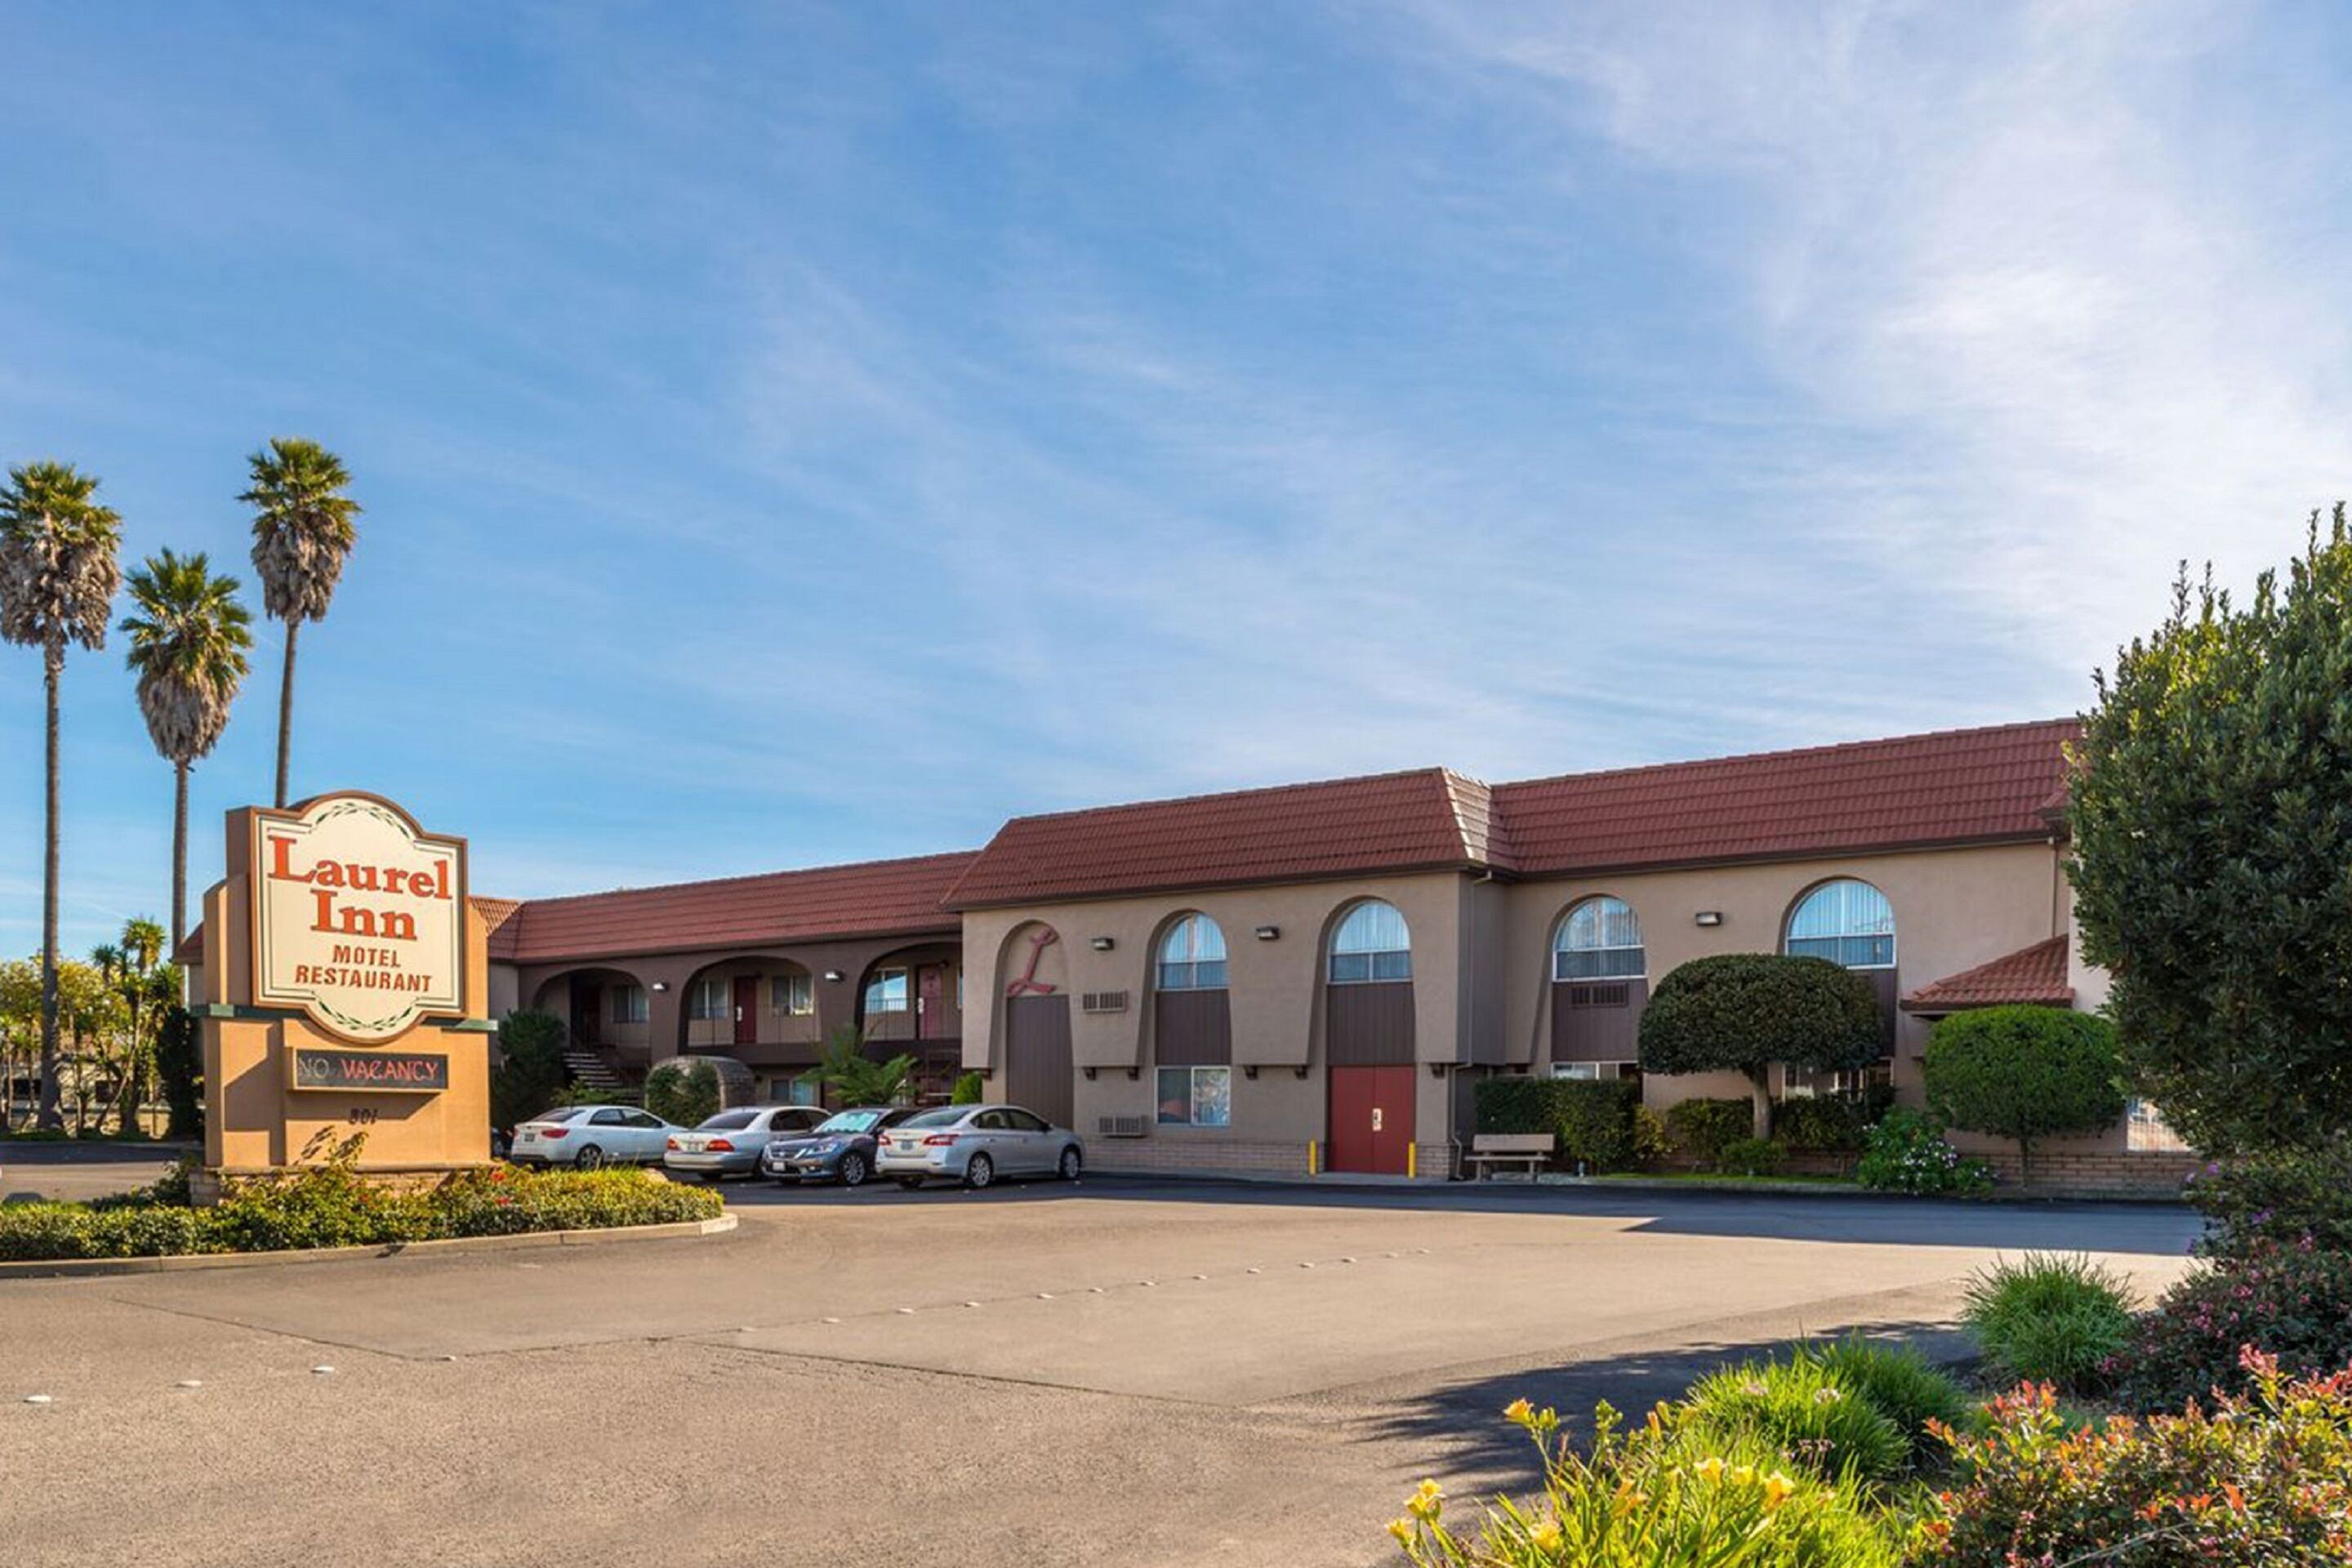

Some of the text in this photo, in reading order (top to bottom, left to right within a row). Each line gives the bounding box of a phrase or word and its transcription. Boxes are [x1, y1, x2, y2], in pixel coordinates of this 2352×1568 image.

[267, 835, 452, 900] Laurel
[310, 888, 417, 941] Inn
[332, 944, 401, 968] MOTEL
[295, 964, 432, 992] RESTAURANT
[298, 1058, 439, 1082] NO VACANCY
